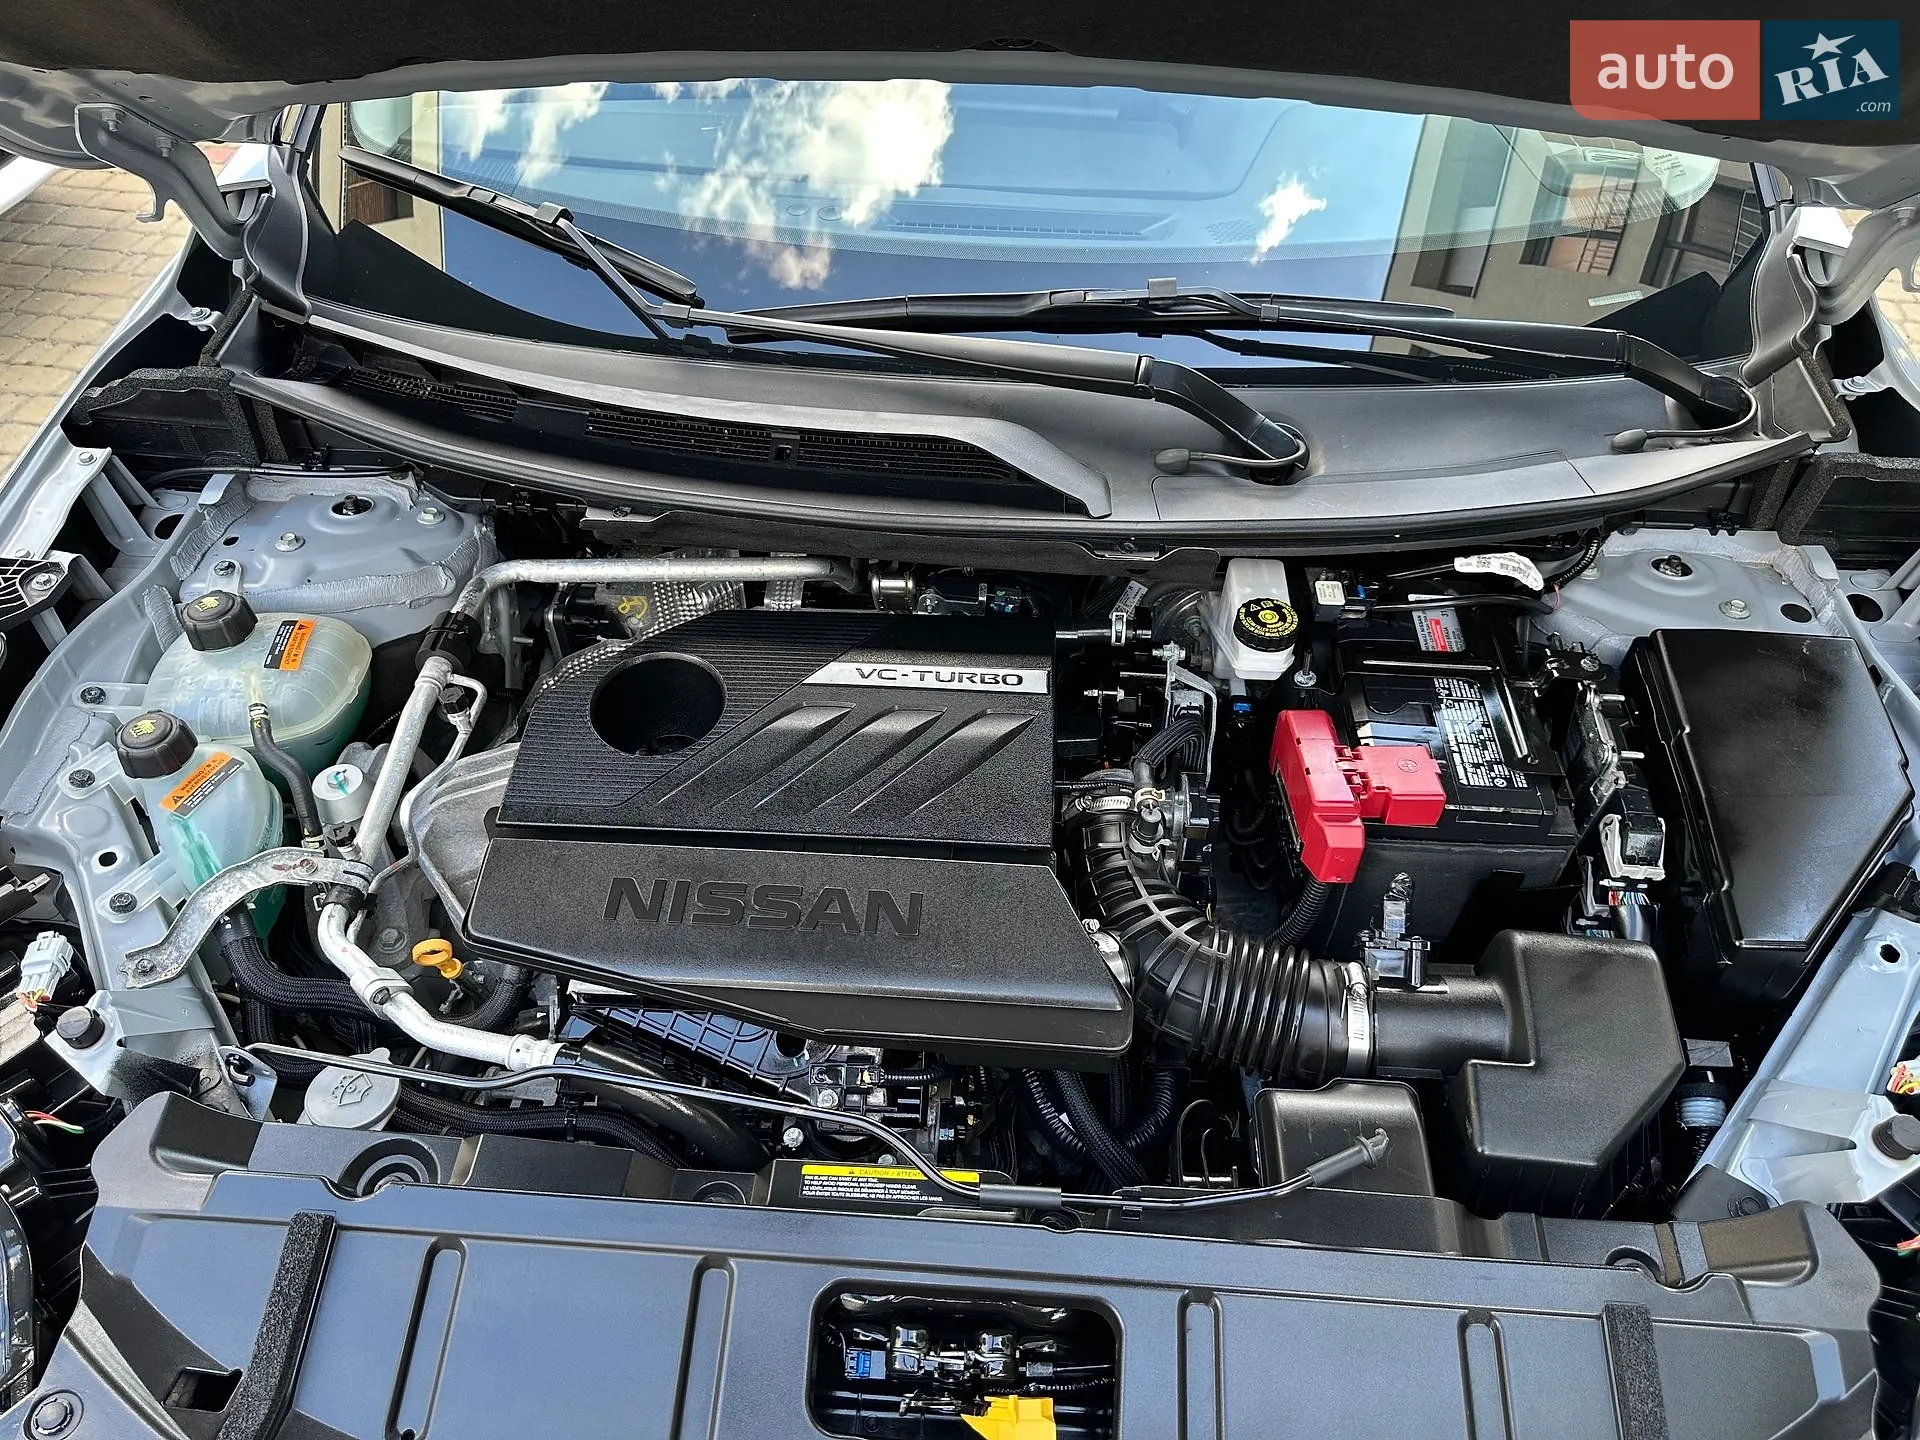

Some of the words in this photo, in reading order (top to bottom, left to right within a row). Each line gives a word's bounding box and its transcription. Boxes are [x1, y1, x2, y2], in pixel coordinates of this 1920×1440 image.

[855, 667, 1024, 686] VC-TURBO
[602, 877, 924, 937] NISSAN
[859, 1169, 889, 1177] CAUTION
